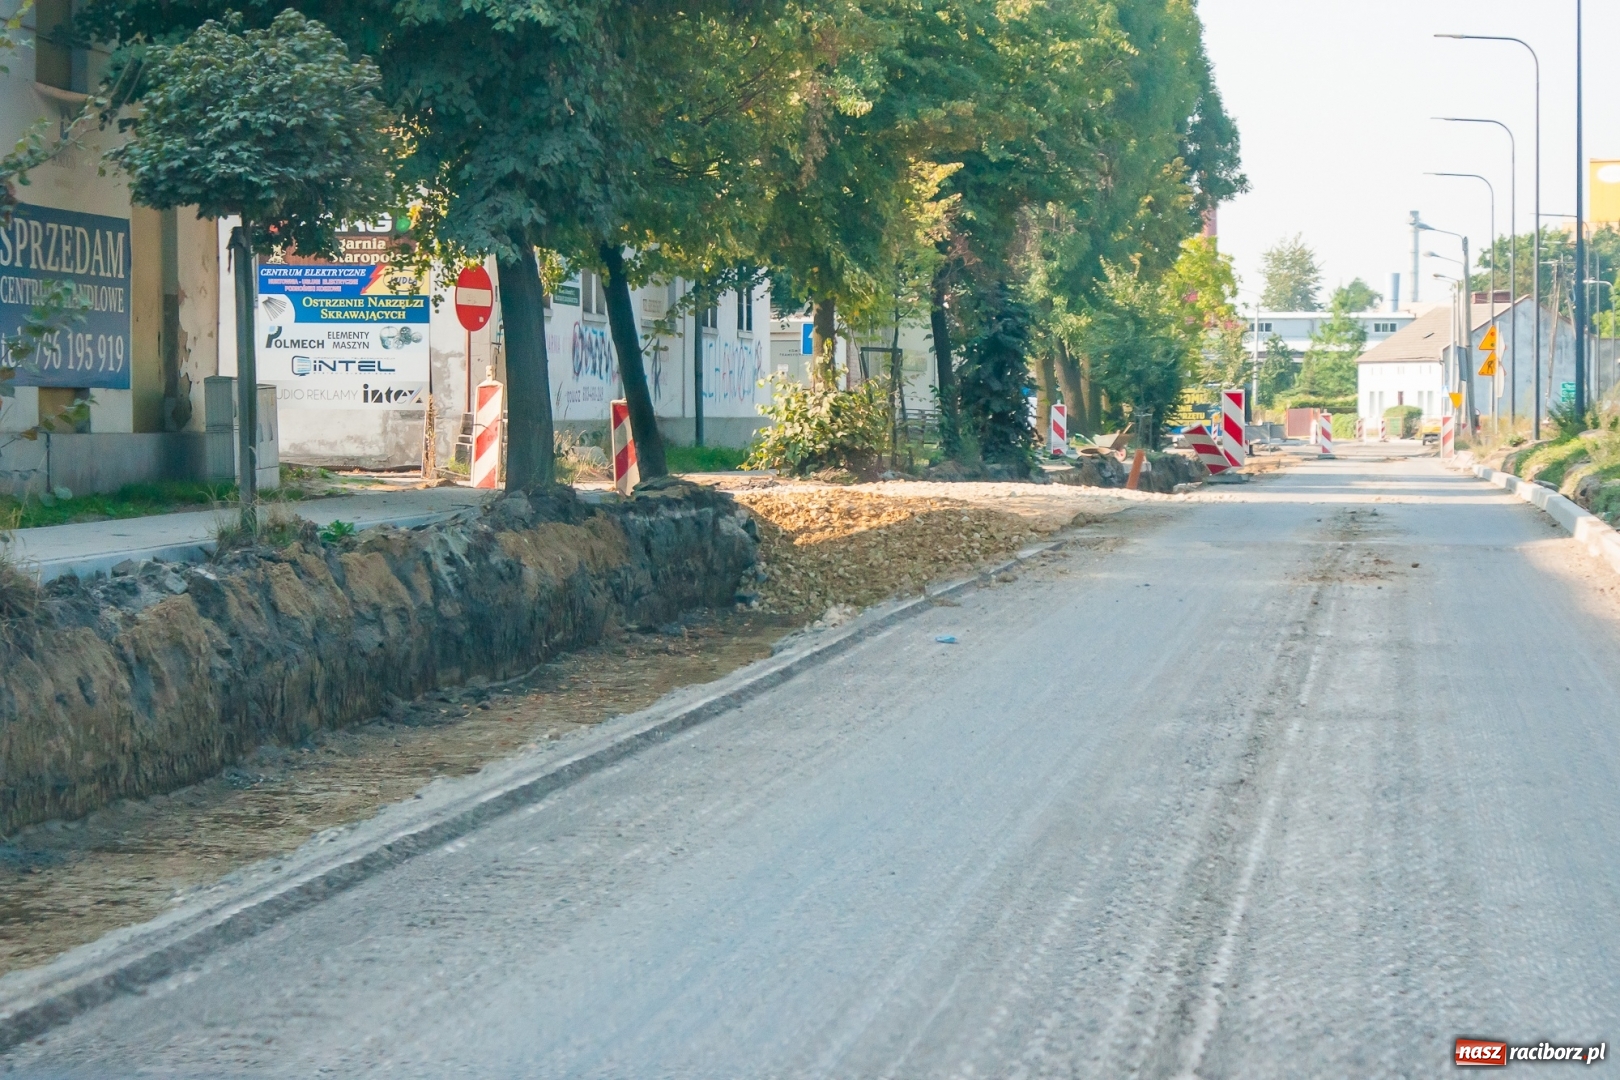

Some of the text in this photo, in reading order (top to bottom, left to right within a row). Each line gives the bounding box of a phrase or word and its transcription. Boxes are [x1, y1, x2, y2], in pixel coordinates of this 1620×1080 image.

[0, 217, 125, 279] SPRZEDAM
[339, 238, 386, 254] garnia
[260, 268, 367, 277] CENTRUM ELEKTRYCZNE
[302, 296, 366, 308] OSTRZENIE
[320, 308, 406, 321] SKRAWAJĄCYCH
[265, 325, 325, 349] POLMECH
[327, 331, 370, 340] ELEMENTY
[332, 341, 370, 350] MASZYN
[67, 333, 94, 372] 195
[97, 334, 124, 373] 919
[275, 388, 305, 401] UDIO
[307, 388, 359, 401] REKLAMY
